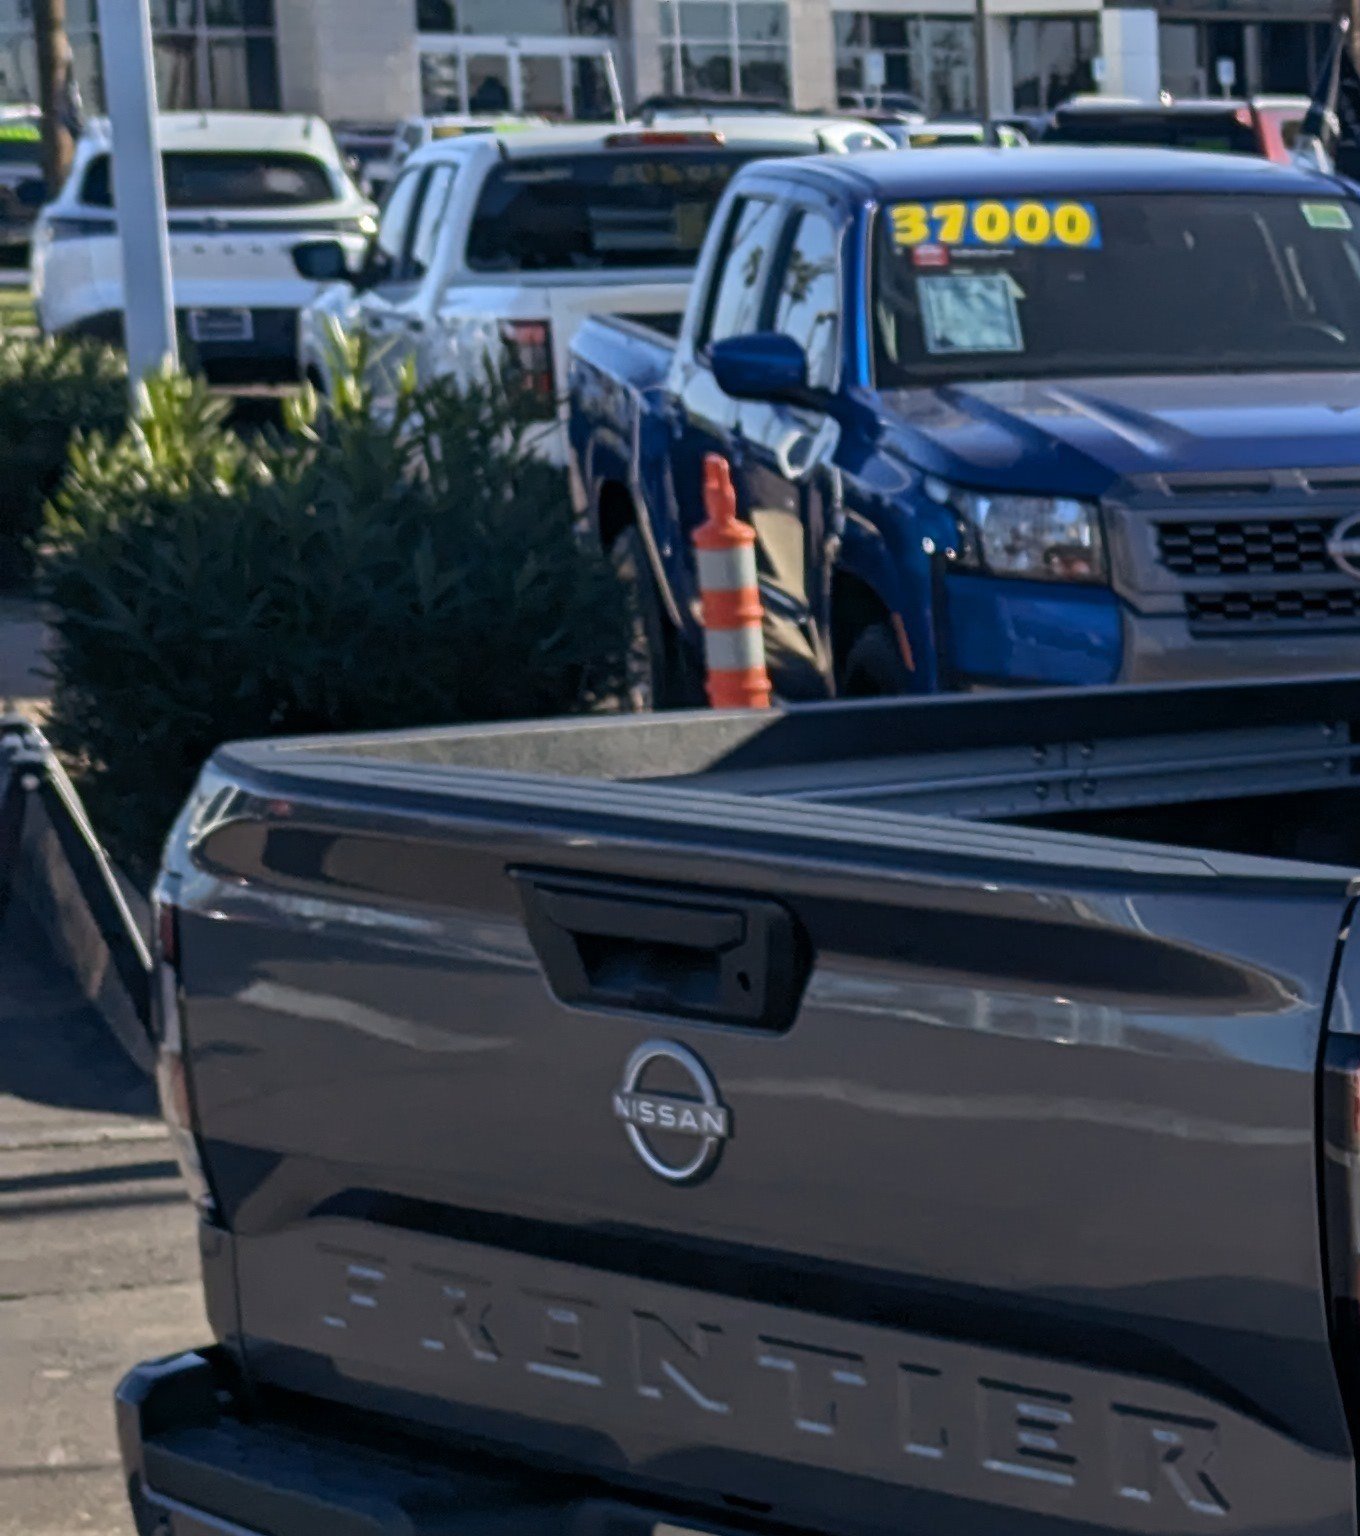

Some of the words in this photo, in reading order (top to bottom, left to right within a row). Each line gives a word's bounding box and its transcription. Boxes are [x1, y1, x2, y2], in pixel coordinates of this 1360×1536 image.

[891, 202, 1092, 245] 37000
[614, 1095, 725, 1136] NISSAN
[316, 1241, 1230, 1517] FRONTIER
